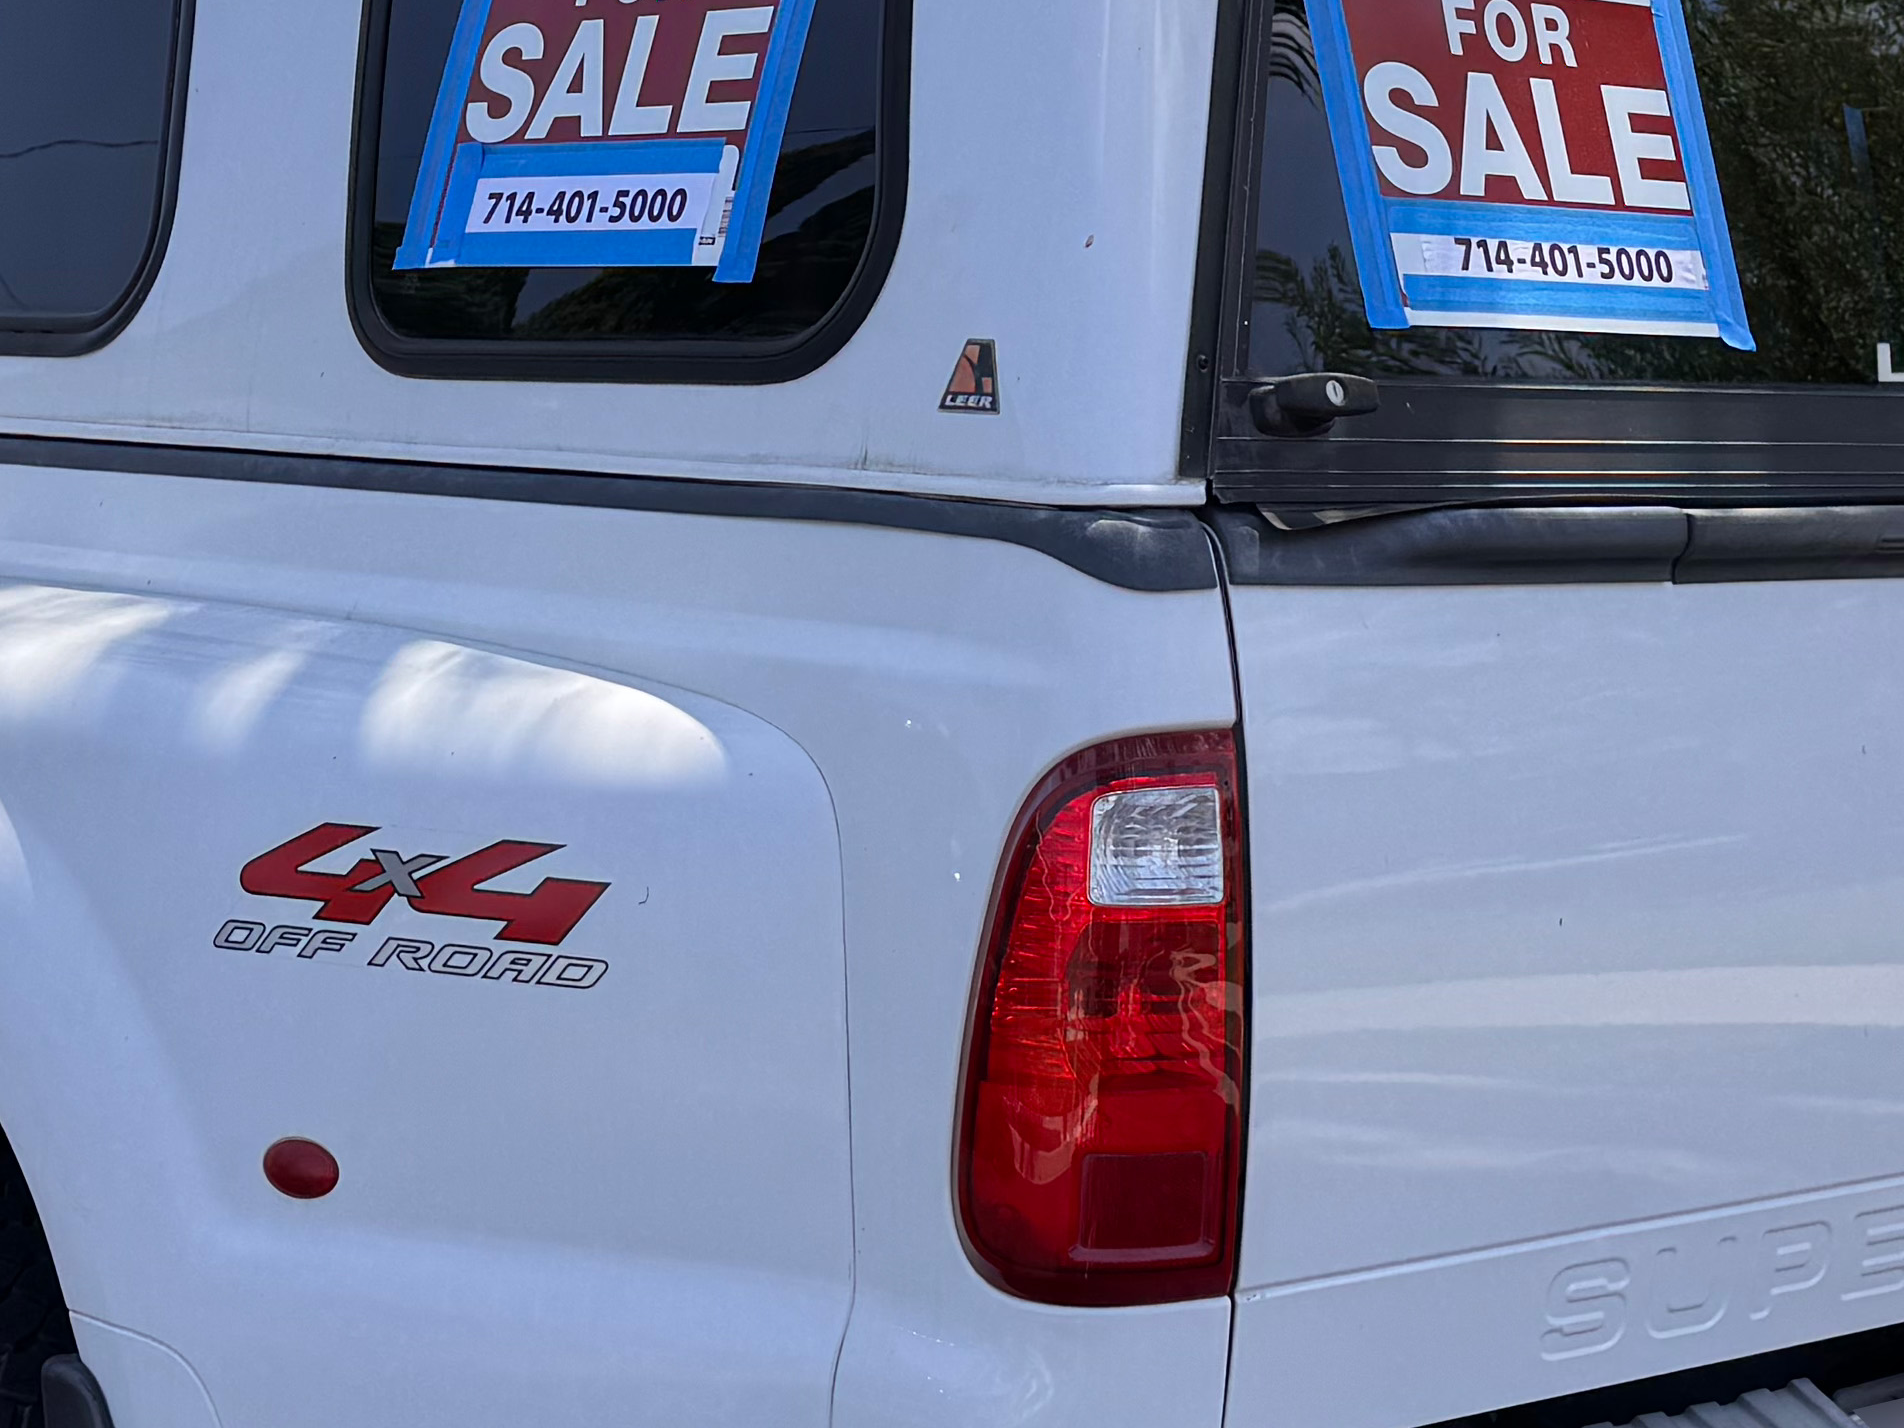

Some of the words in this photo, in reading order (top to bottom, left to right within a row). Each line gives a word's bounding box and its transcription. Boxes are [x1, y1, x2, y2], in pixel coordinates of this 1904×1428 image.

[464, 5, 774, 145] SALE
[1362, 60, 1692, 211] SALE
[482, 186, 689, 227] 714-401-5000
[1453, 236, 1674, 286] 714-401-5000
[945, 395, 993, 408] LEER
[212, 918, 357, 959] OFF
[368, 936, 611, 990] ROAD
